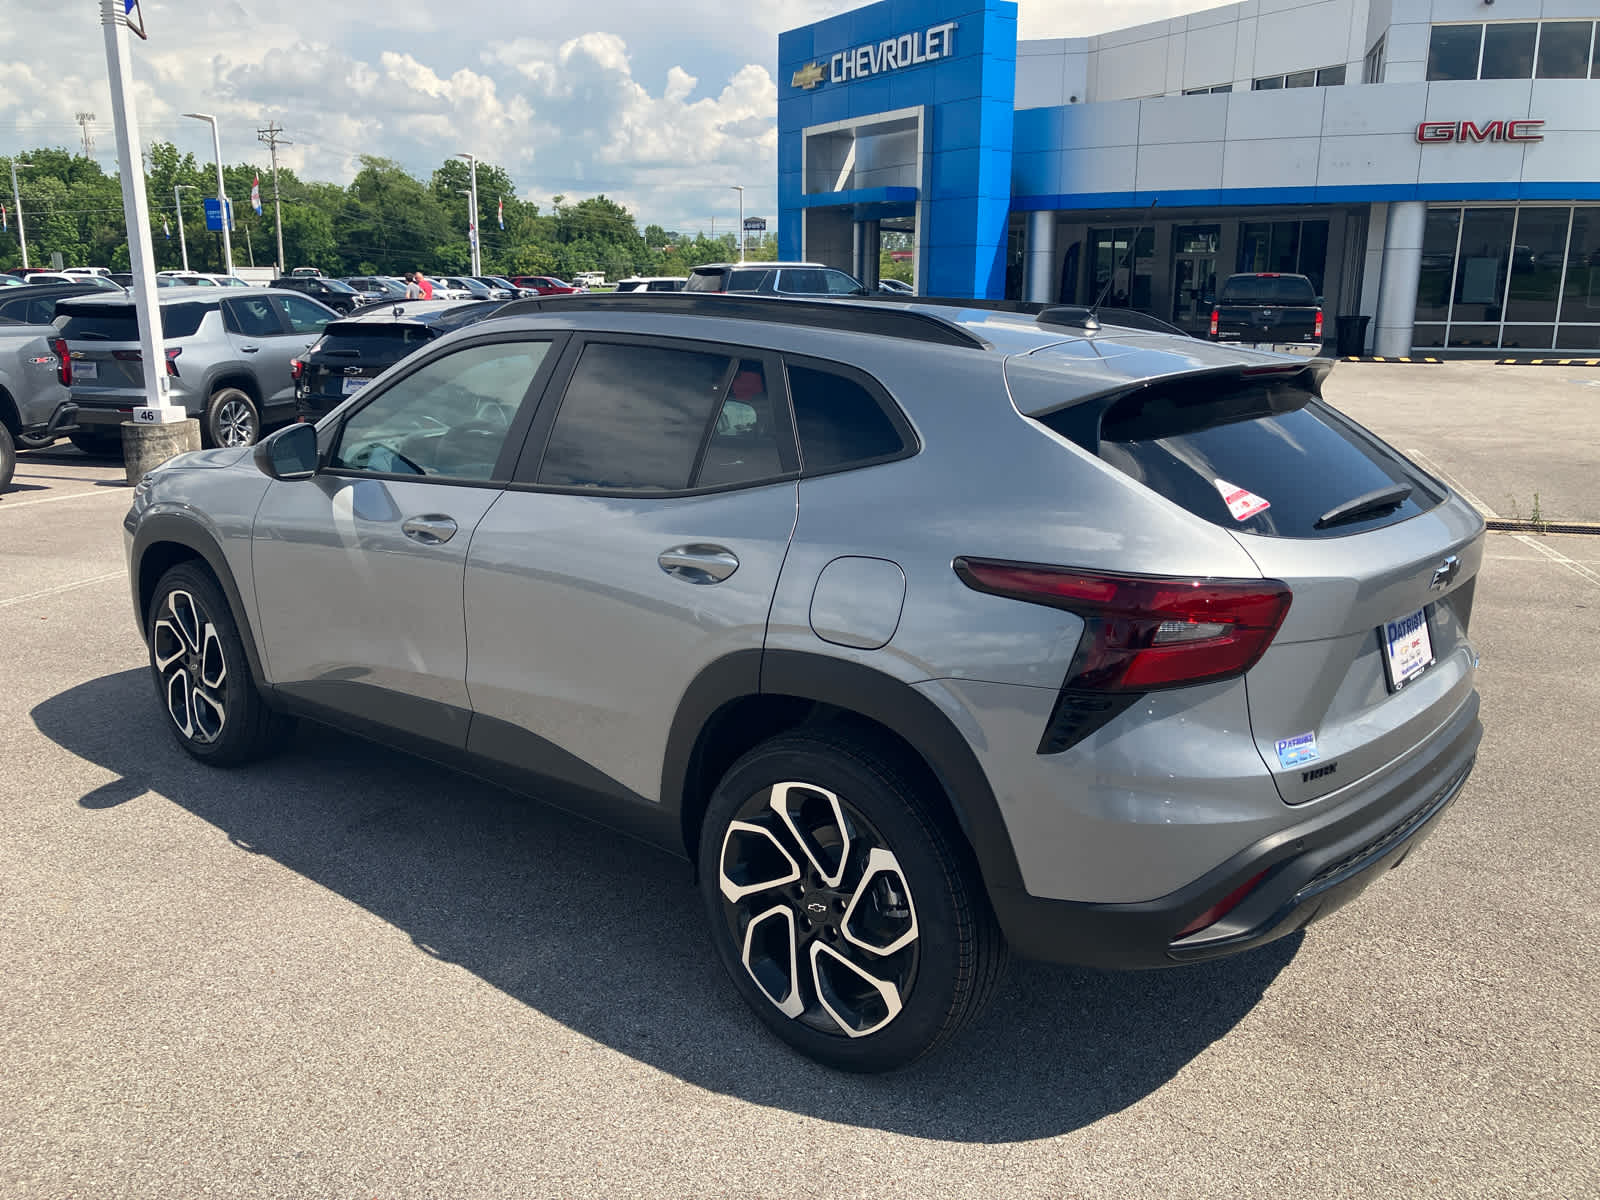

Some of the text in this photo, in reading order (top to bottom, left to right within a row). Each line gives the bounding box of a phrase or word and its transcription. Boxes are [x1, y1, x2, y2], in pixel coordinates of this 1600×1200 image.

[831, 22, 958, 83] CHEVROLET
[1416, 120, 1544, 143] GMC
[141, 411, 154, 421] 46
[1387, 610, 1423, 657] PATRIOT
